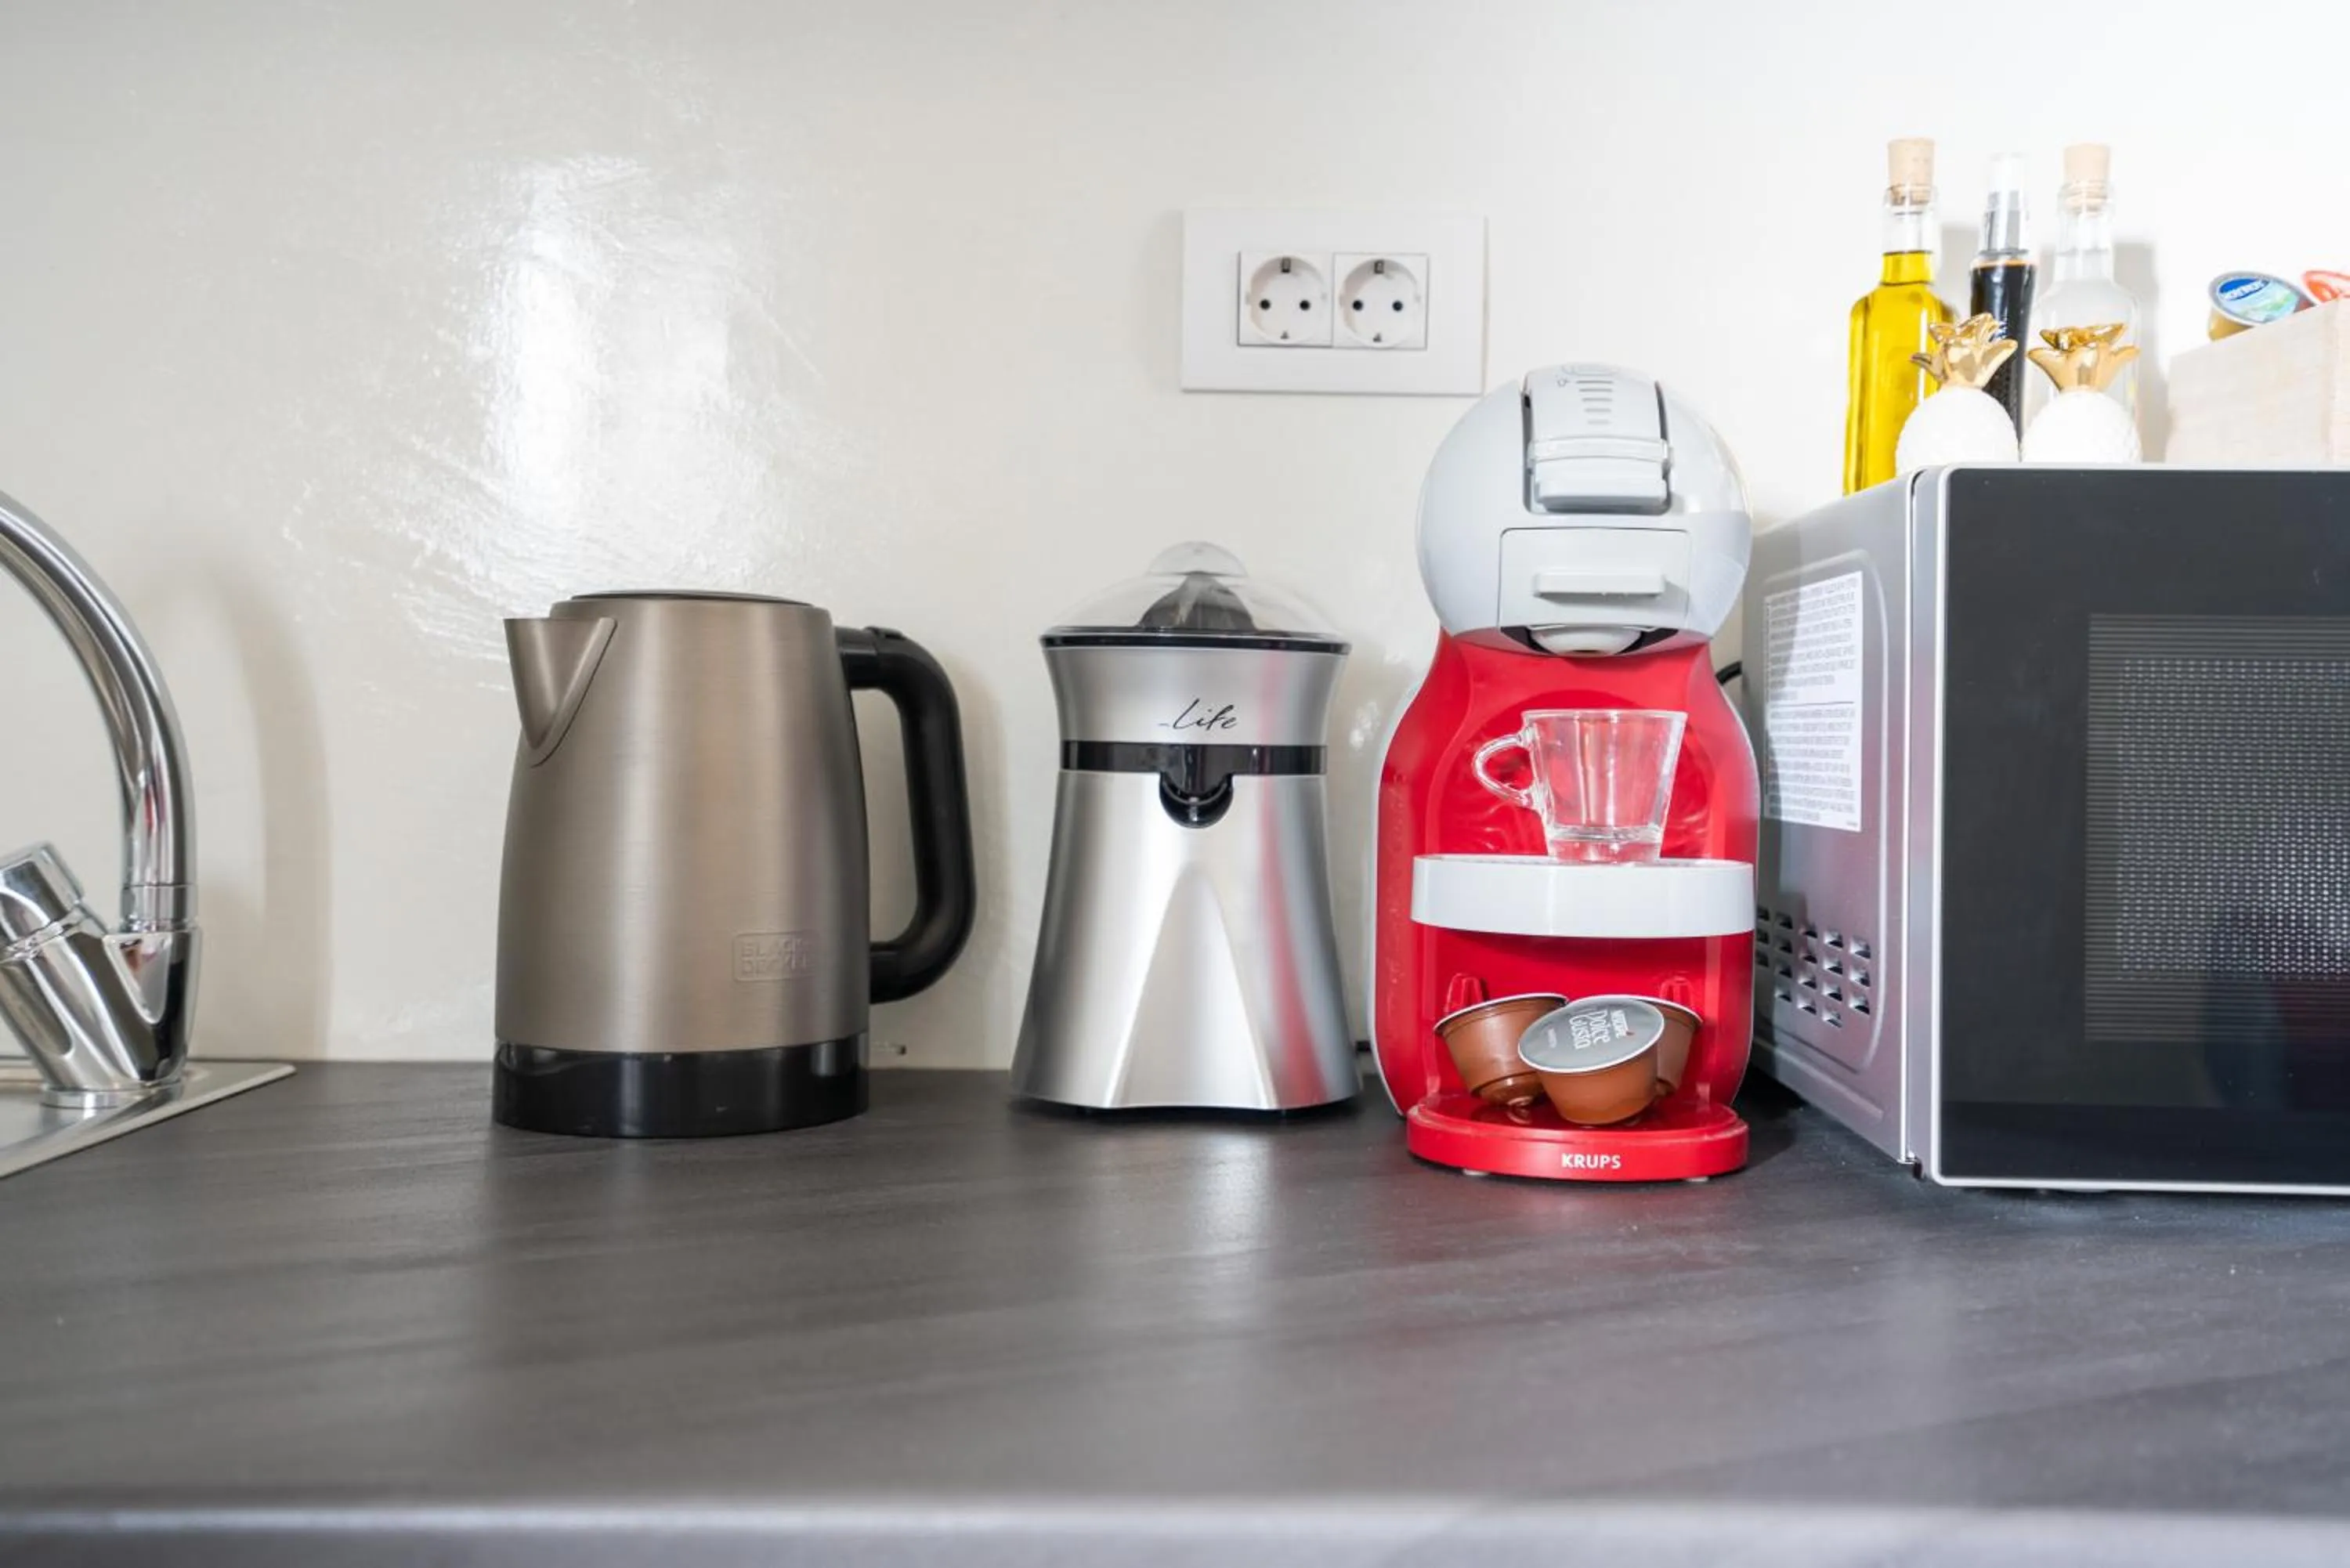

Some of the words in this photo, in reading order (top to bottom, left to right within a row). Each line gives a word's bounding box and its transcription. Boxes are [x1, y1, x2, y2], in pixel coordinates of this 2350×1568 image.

[1159, 698, 1238, 731] Life
[1569, 1014, 1592, 1050] Gusto
[1588, 1009, 1611, 1045] Dolce
[1561, 1153, 1622, 1169] KRUPS
